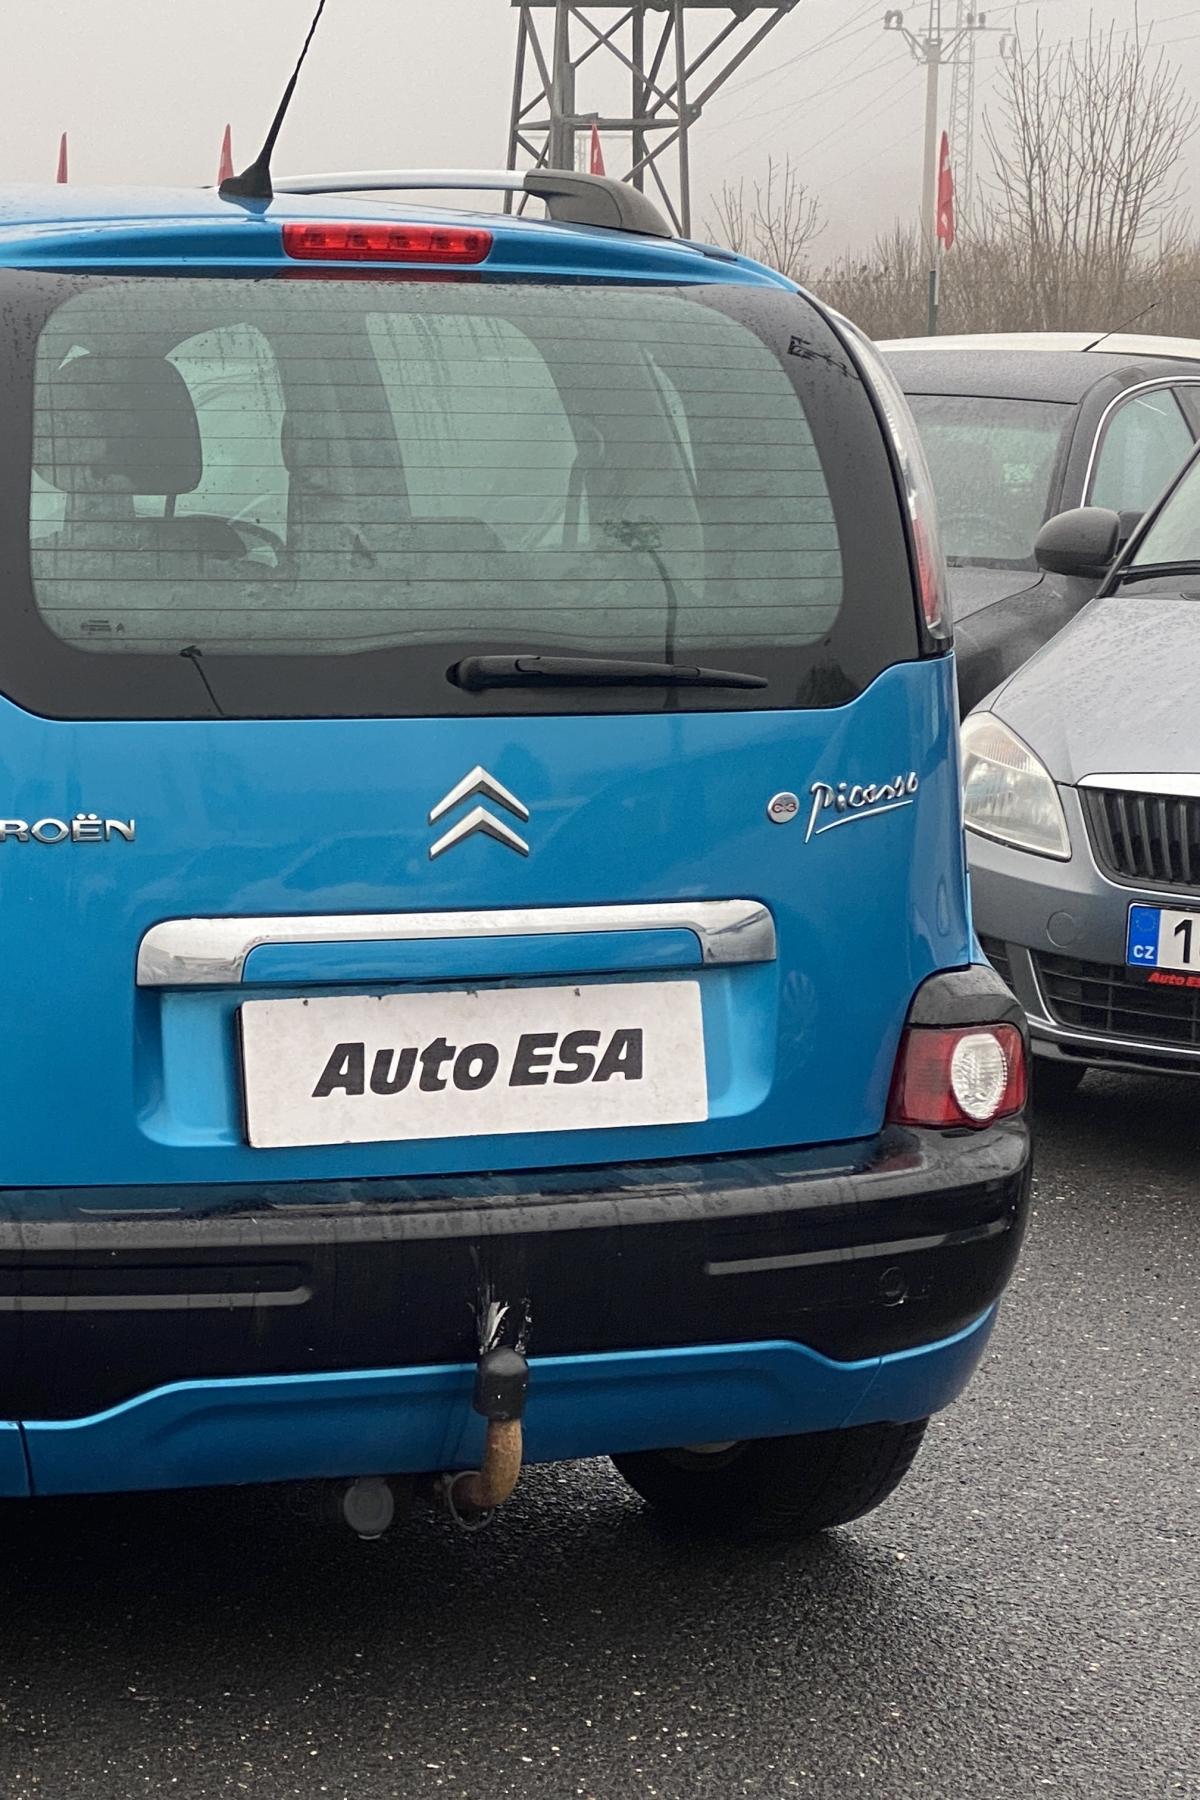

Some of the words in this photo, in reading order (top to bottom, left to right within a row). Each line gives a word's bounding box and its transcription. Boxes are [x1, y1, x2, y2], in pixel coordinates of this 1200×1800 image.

[804, 772, 919, 843] Picasso
[1133, 944, 1155, 960] CZ
[1173, 919, 1196, 964] 1
[1148, 971, 1186, 986] Auto
[311, 1037, 499, 1098] Auto
[508, 1028, 643, 1087] ESA
